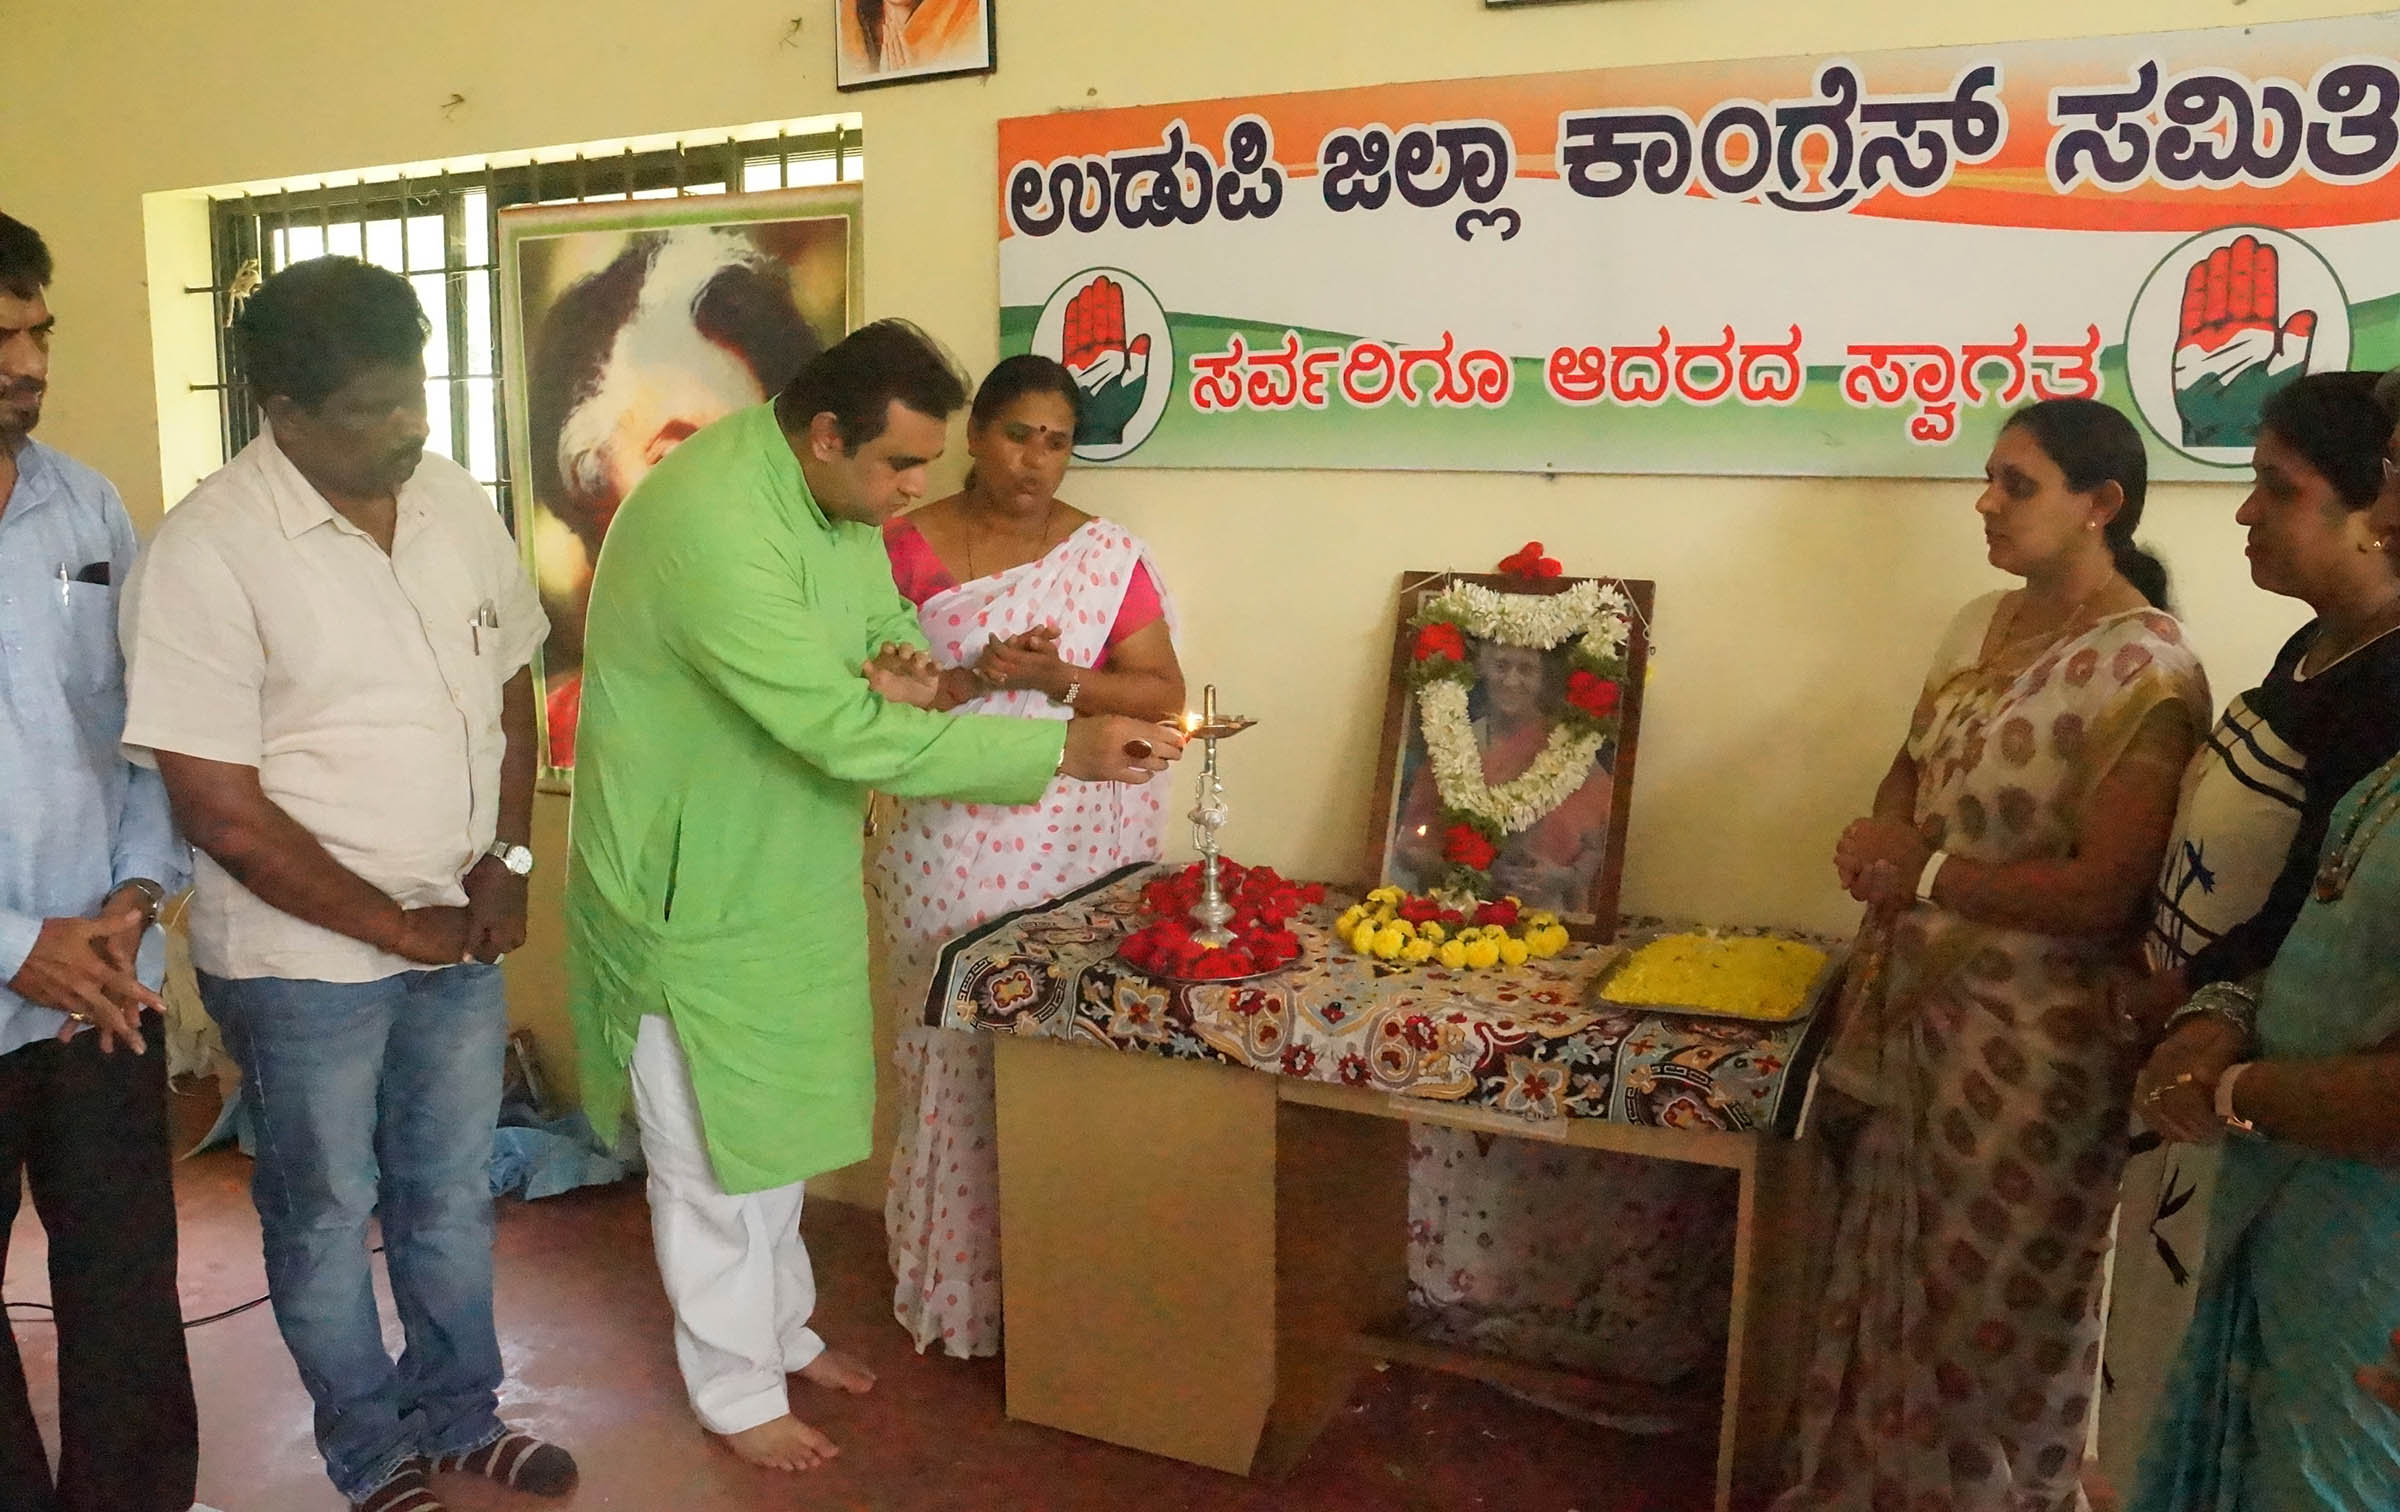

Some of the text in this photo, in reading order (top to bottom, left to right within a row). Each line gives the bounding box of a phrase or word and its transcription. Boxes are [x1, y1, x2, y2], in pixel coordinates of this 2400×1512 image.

[1011, 59, 2400, 242] ಉಡುಪಿ ಜಿಲ್ಲಾ ಕಾಂಗ್ರೆಸ್ ಸಮಿತಿ
[1193, 323, 2102, 442] ಸರ್ವರಿಗೂ ಆದರದ ಸ್ವಾಗತ
